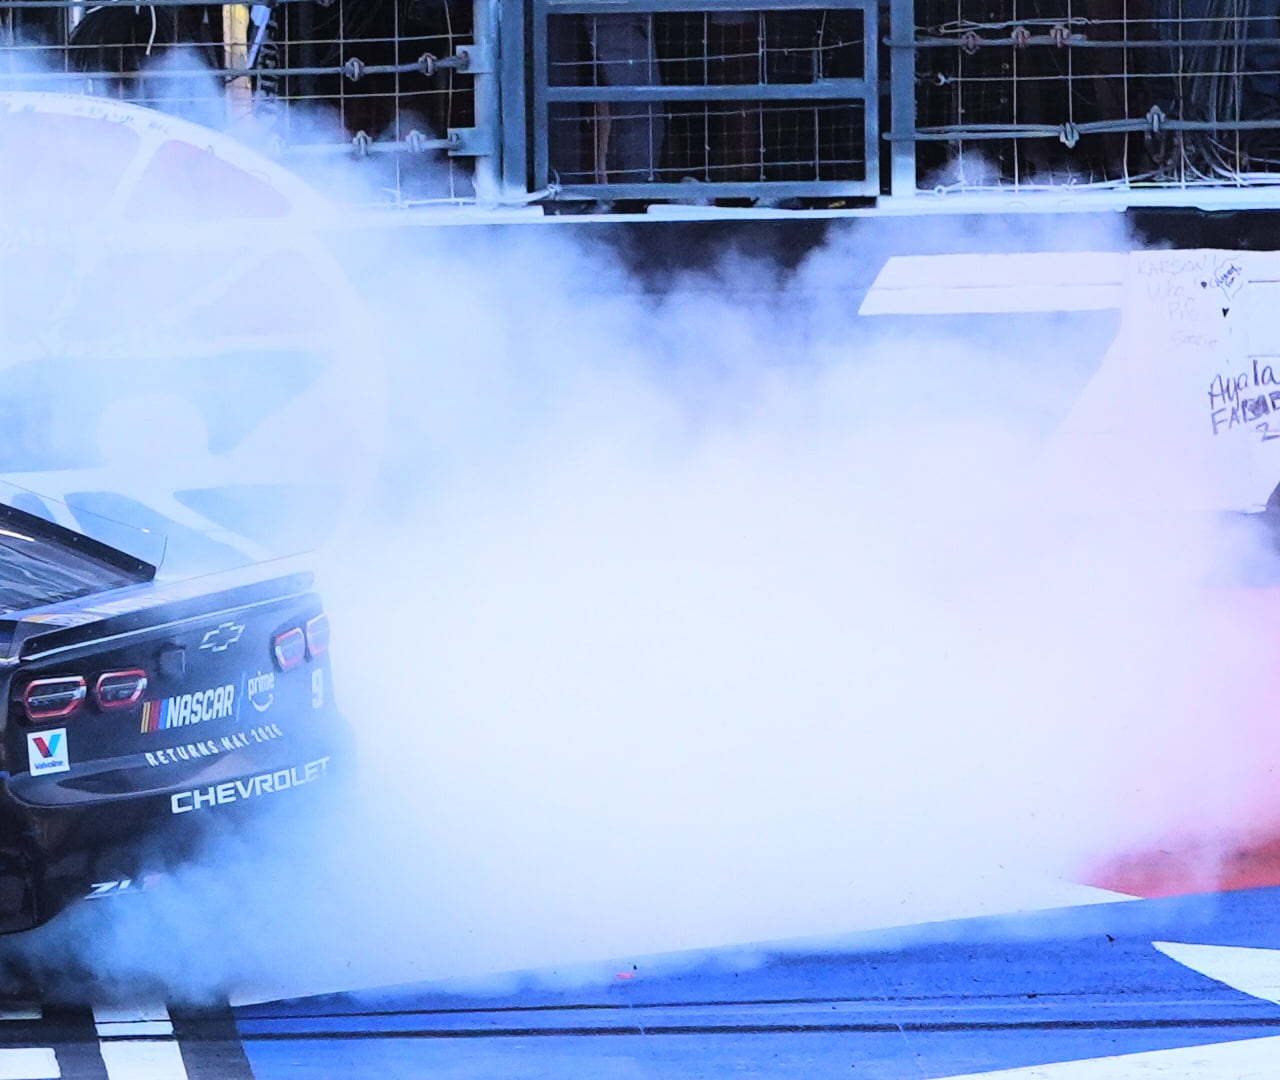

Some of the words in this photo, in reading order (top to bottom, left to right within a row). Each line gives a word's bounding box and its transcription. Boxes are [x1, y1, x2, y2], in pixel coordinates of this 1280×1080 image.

[165, 684, 235, 729] NASCAR
[247, 669, 275, 700] prime
[310, 668, 324, 709] 9
[144, 739, 220, 768] RETURNS
[221, 732, 251, 752] MAY
[249, 723, 284, 744] 2026
[170, 756, 331, 815] CHEVROLET
